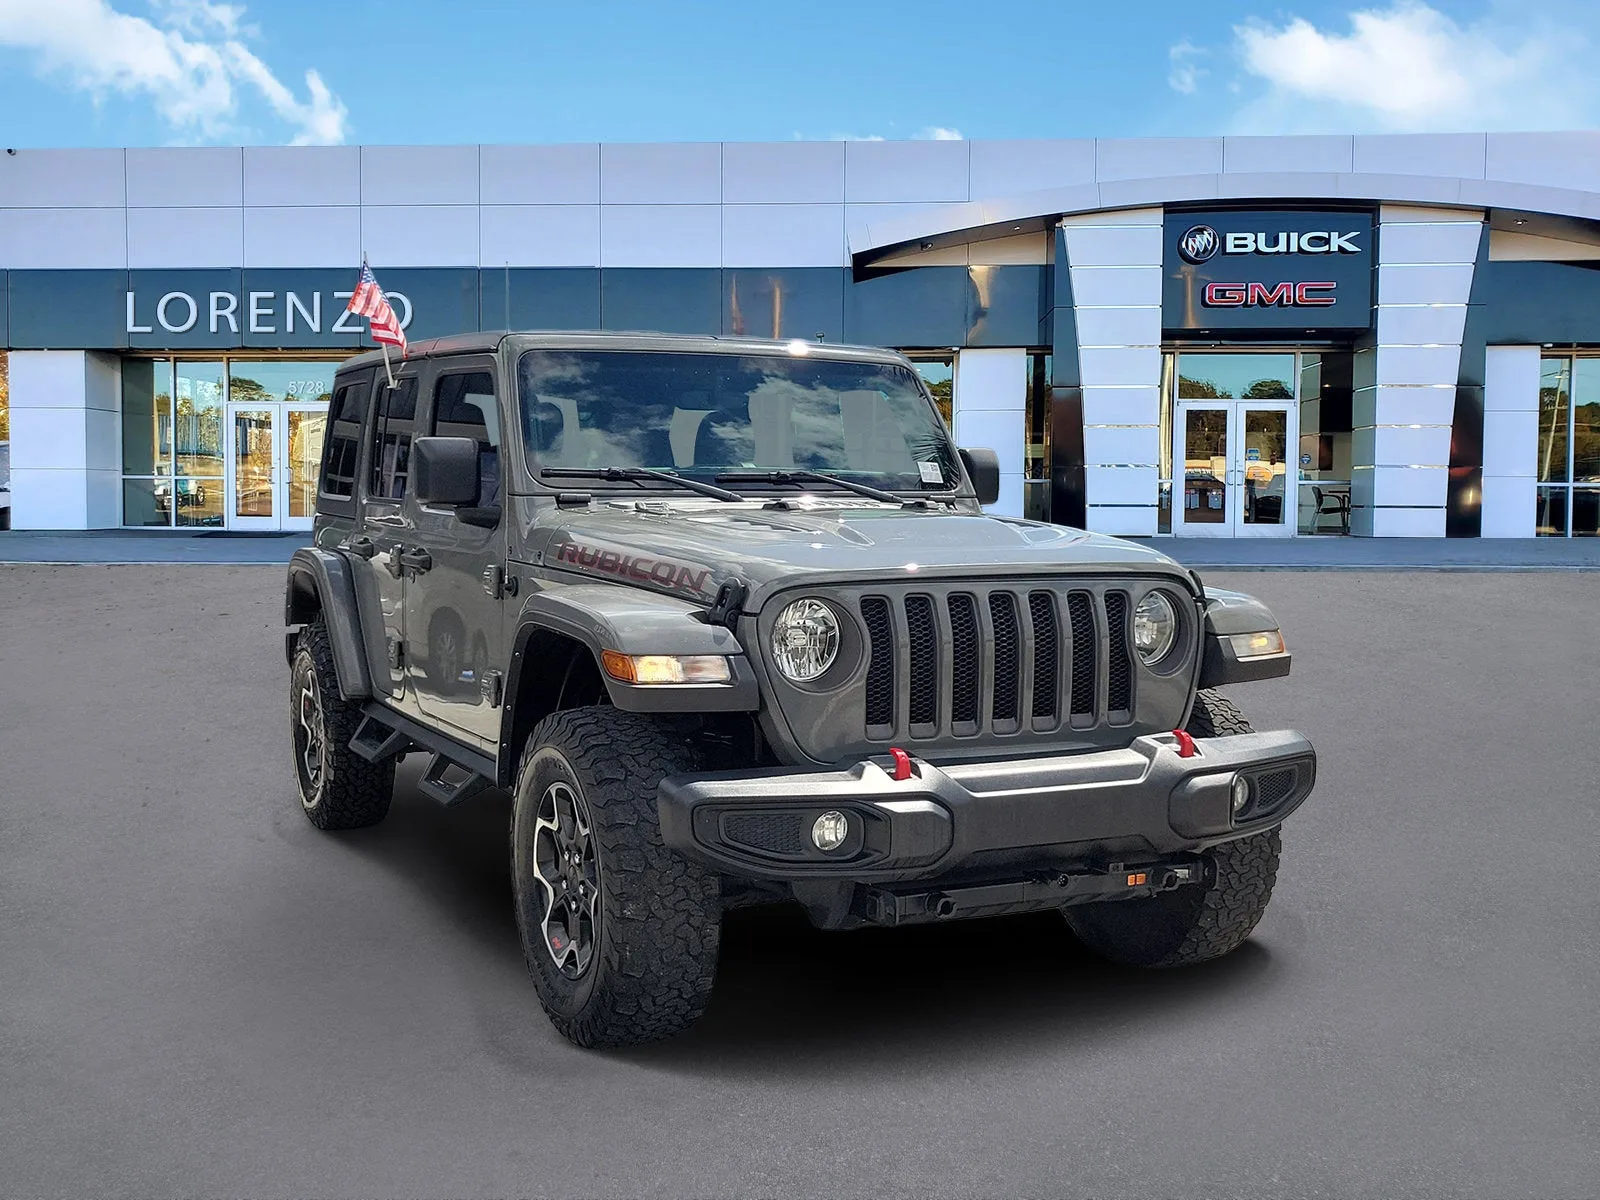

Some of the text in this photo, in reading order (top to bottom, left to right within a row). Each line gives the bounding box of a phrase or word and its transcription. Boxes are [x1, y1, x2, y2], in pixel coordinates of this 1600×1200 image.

[1226, 231, 1362, 253] BUICK
[1205, 281, 1337, 305] GMC
[288, 380, 325, 394] 5728
[556, 542, 710, 592] RUBICON
